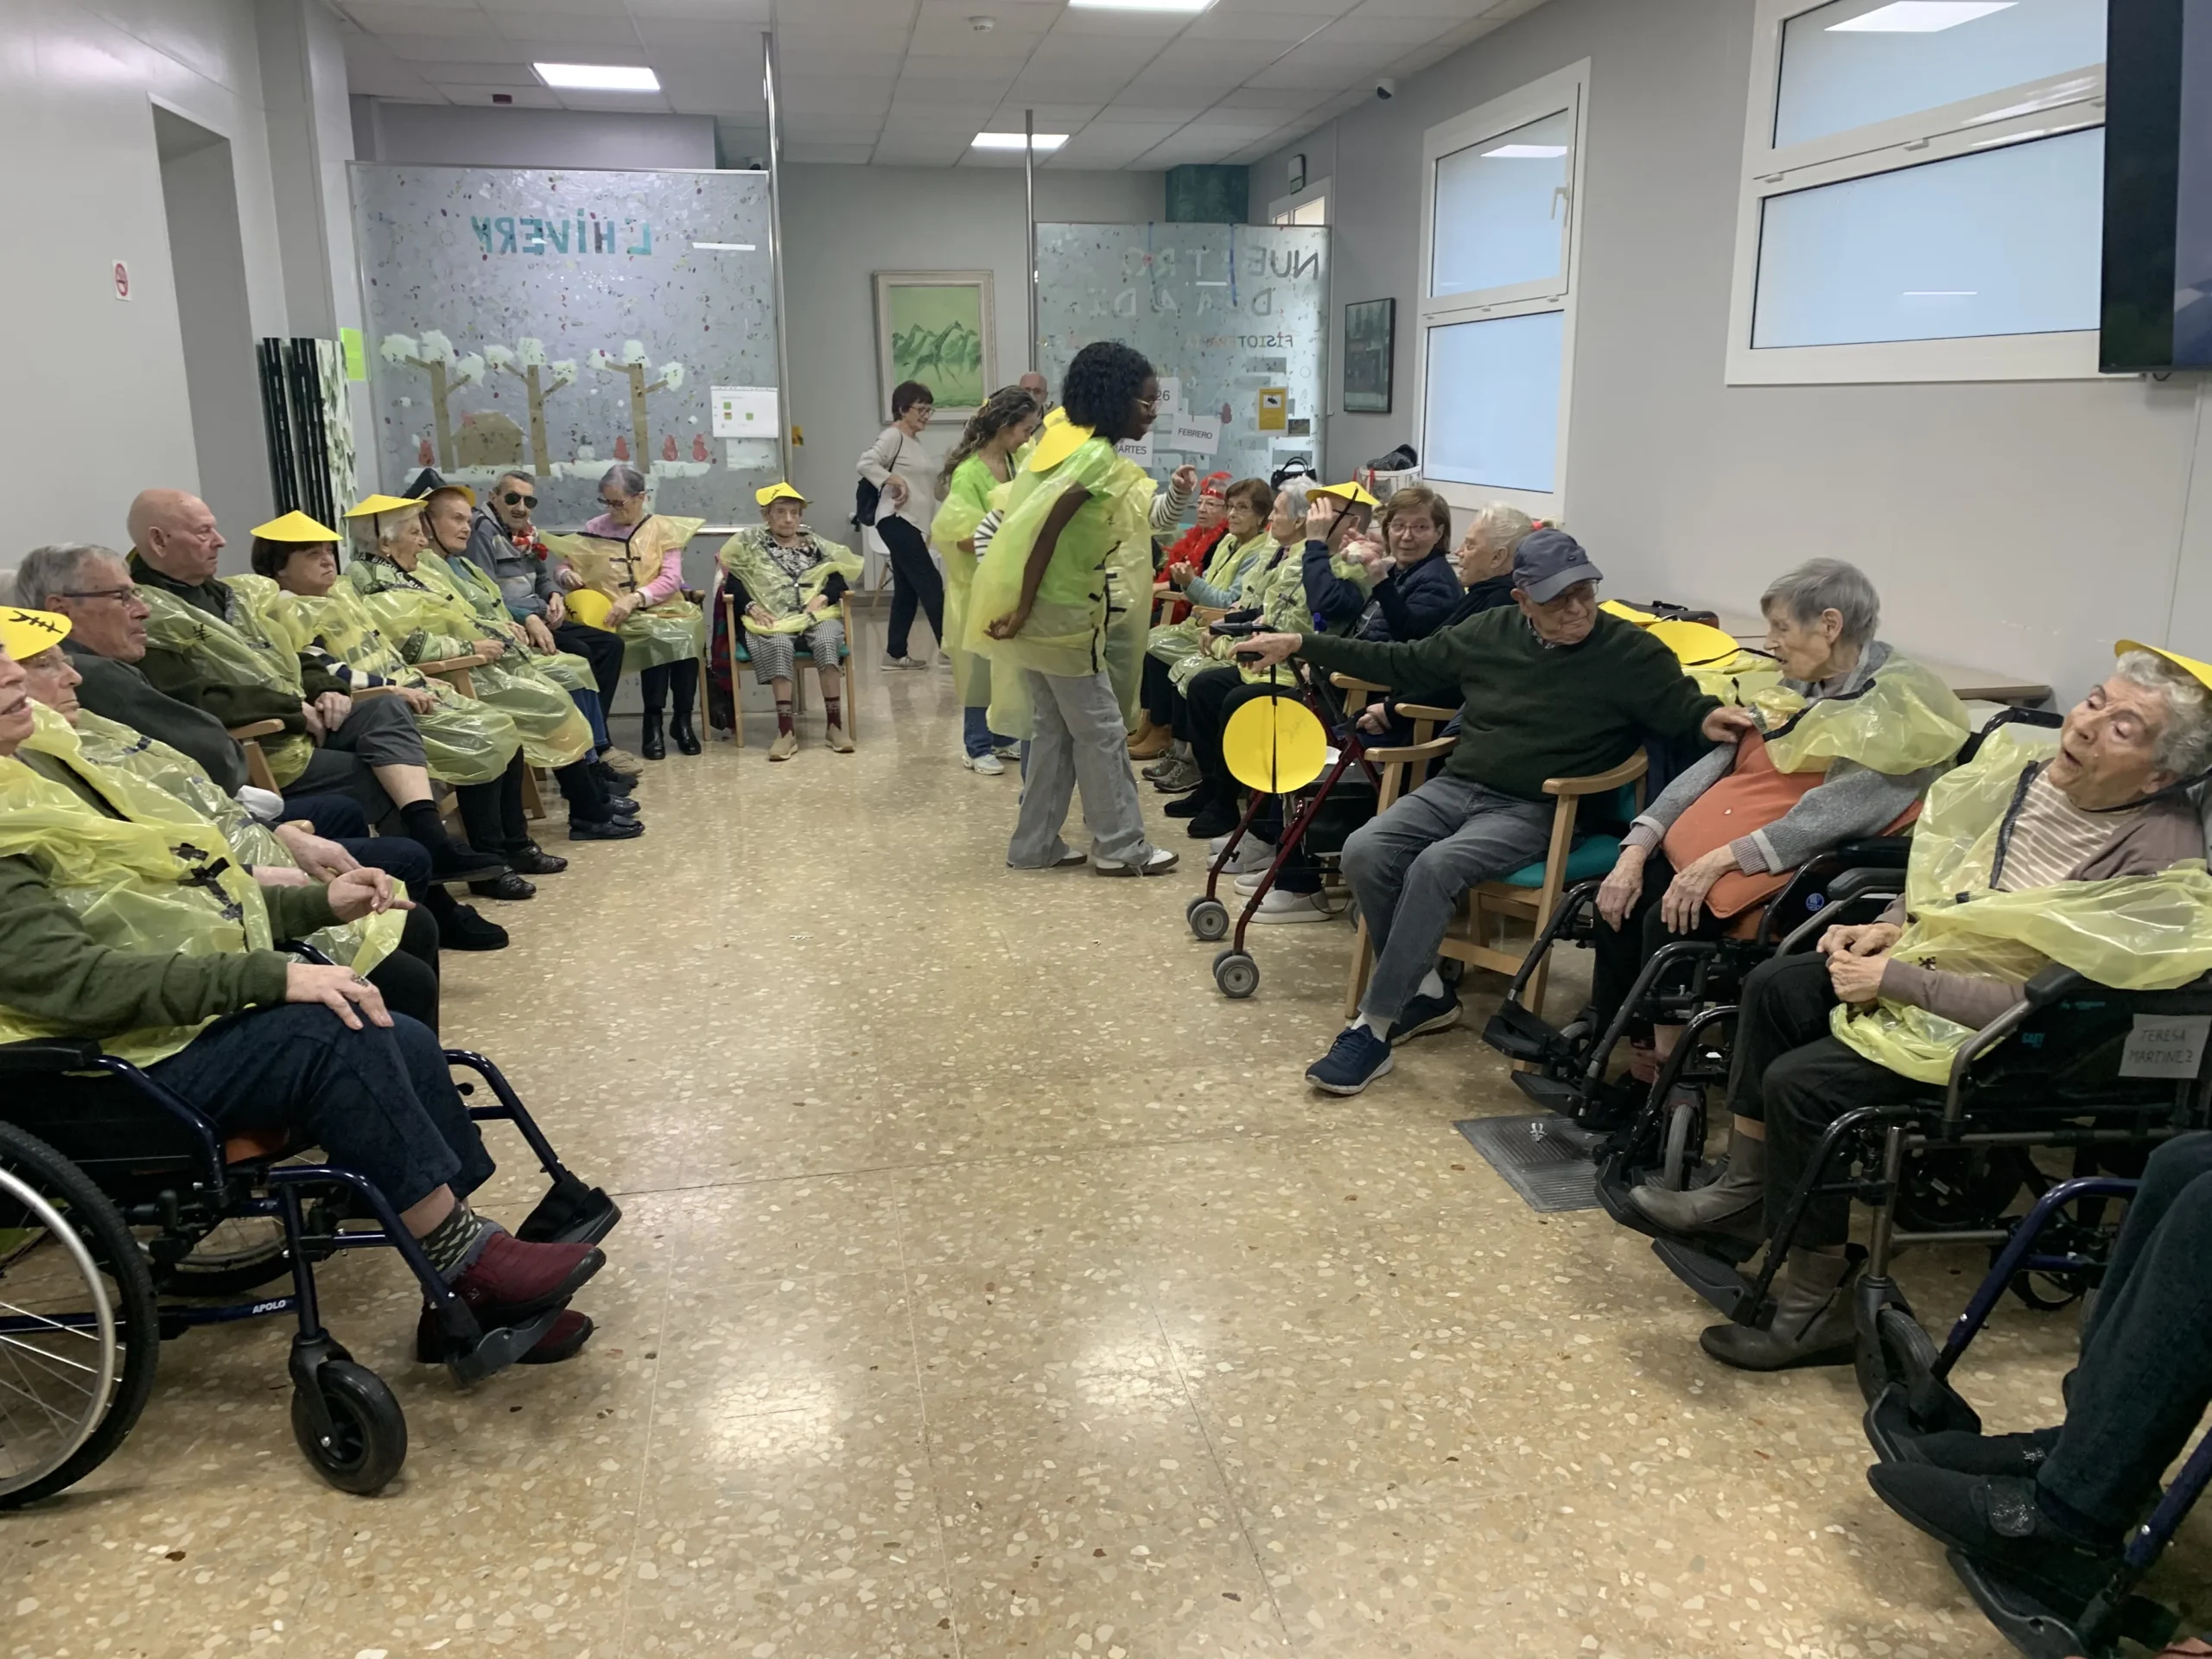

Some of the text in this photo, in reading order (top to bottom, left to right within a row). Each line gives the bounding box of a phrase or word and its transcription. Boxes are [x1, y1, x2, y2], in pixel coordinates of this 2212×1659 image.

[1178, 427, 1213, 440] FEBRERO
[2142, 1028, 2186, 1042] TERESA
[251, 1300, 287, 1314] APOLO
